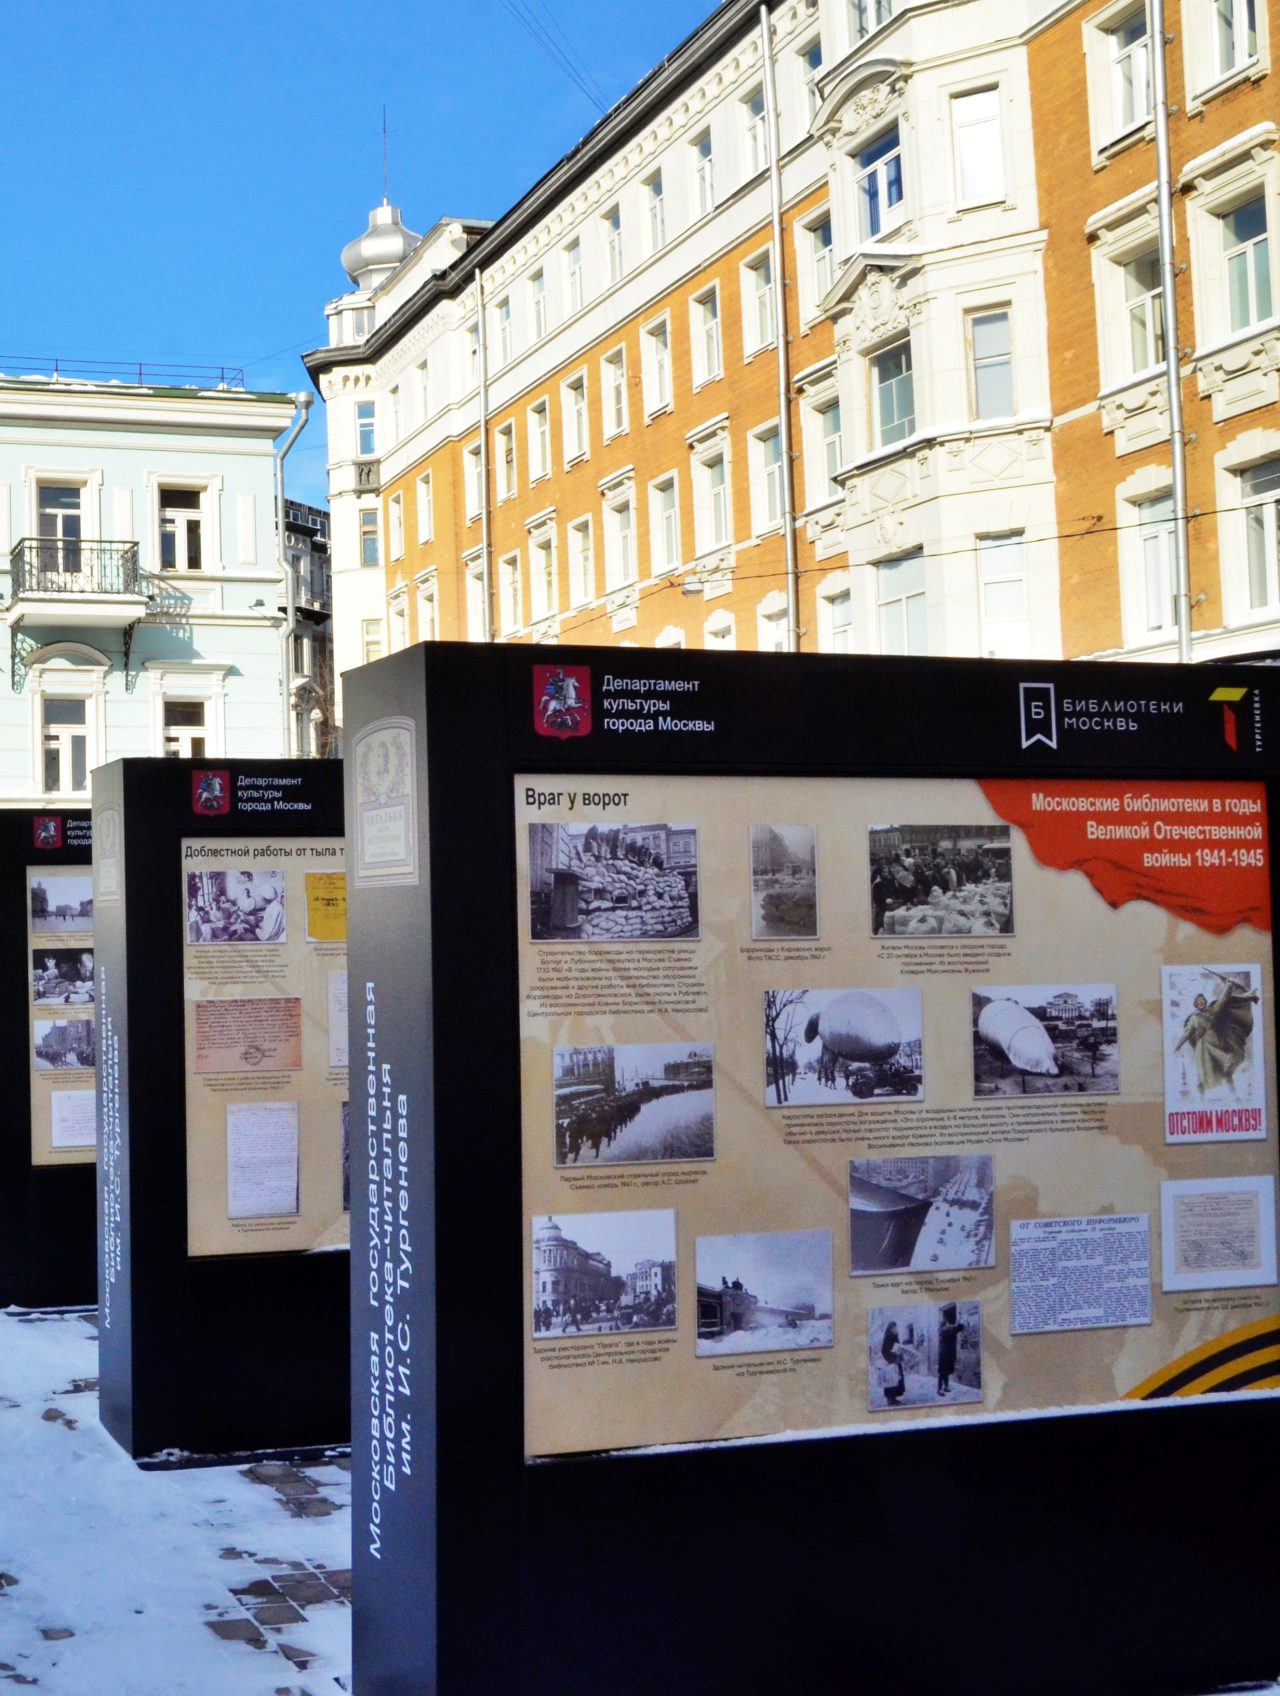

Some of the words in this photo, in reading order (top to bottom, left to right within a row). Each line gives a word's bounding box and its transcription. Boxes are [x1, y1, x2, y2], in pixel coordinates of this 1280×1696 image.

[602, 675, 699, 694] Департамент
[603, 699, 670, 714] культуры
[1063, 699, 1183, 713] БИБЛИОТЕКИ
[604, 718, 654, 732] города
[658, 716, 715, 731] Москвы
[237, 775, 302, 787] Департамент
[238, 790, 282, 800] культуры
[525, 787, 564, 810] Враг
[567, 792, 577, 811] у
[582, 792, 630, 811] ворот
[1032, 793, 1120, 812] Московские
[1123, 793, 1209, 812] библиотеки
[1212, 799, 1222, 812] в
[1225, 799, 1261, 815] годы
[238, 802, 271, 812] города
[274, 801, 312, 811] Москвы
[1087, 821, 1150, 839] Великой
[1153, 821, 1262, 840] Отечественной
[185, 845, 250, 860] Доблестной
[253, 846, 293, 860] работы
[295, 848, 307, 857] от
[310, 848, 337, 857] тыла
[1143, 848, 1191, 867] войны
[1195, 848, 1264, 867] 1941-1945
[1169, 1111, 1213, 1135] ОТСТОИМ
[1215, 1108, 1261, 1133] МОСКВУ!
[366, 982, 381, 1307] государственная
[397, 1094, 413, 1294] Тургенева
[382, 1063, 396, 1492] Библиотека-читальня
[370, 1332, 381, 1560] Московская
[401, 1412, 412, 1476] им.
